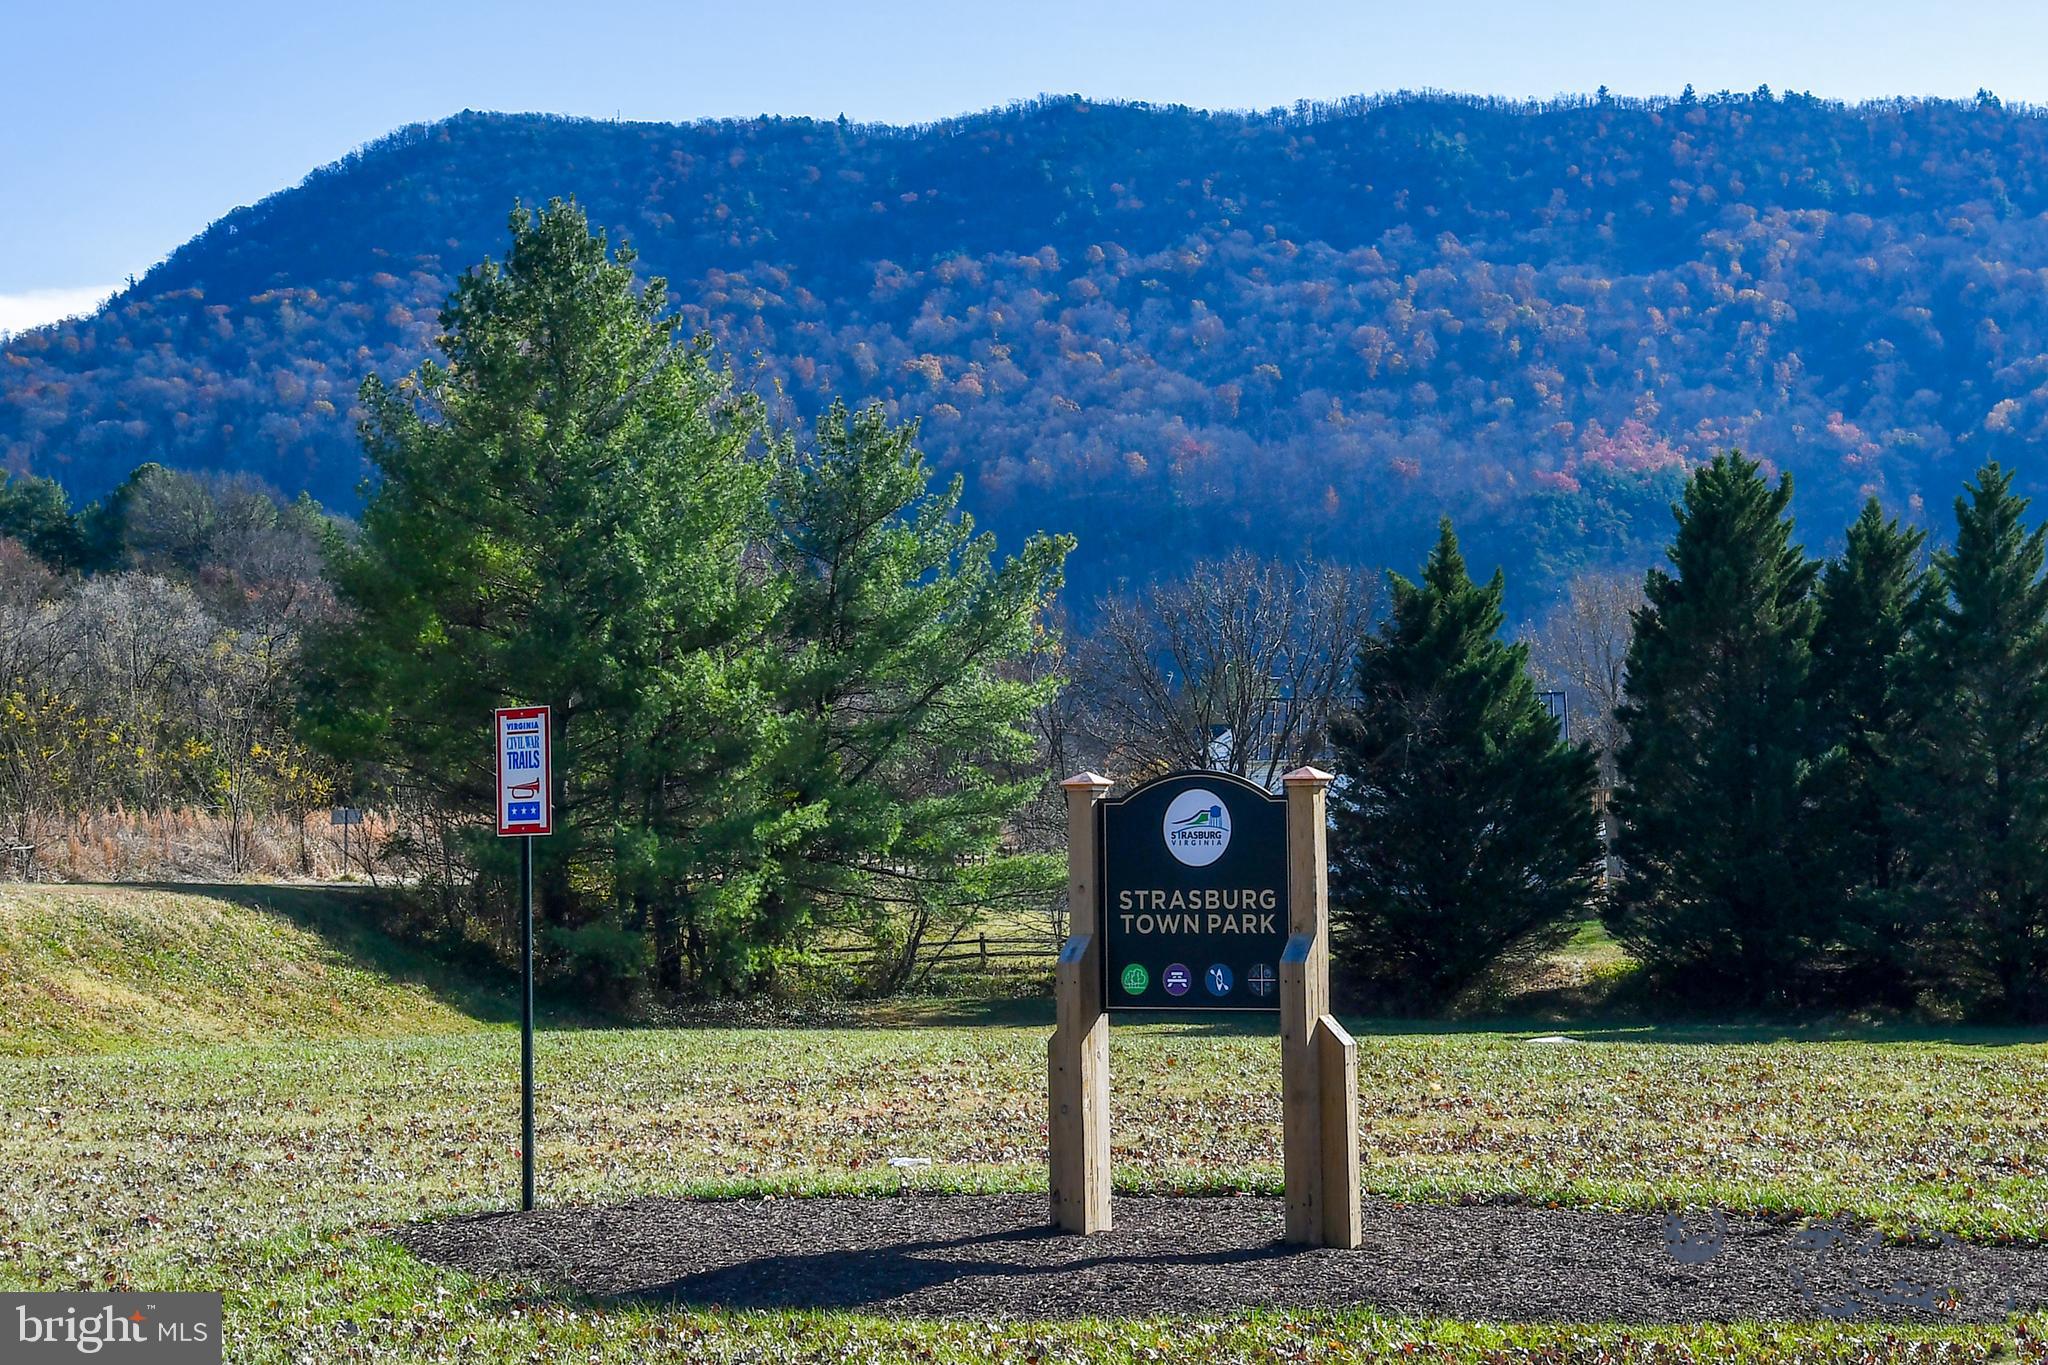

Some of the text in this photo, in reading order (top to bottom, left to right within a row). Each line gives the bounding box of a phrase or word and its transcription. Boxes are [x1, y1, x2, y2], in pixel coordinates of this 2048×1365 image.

[507, 721, 539, 730] VIRGINIA
[507, 735, 540, 750] CIVIL WAR
[507, 750, 540, 769] TRAILS
[1171, 830, 1222, 840] STRASBURG
[1119, 889, 1276, 910] STRASBURG
[1120, 913, 1276, 934] TOWN PARK
